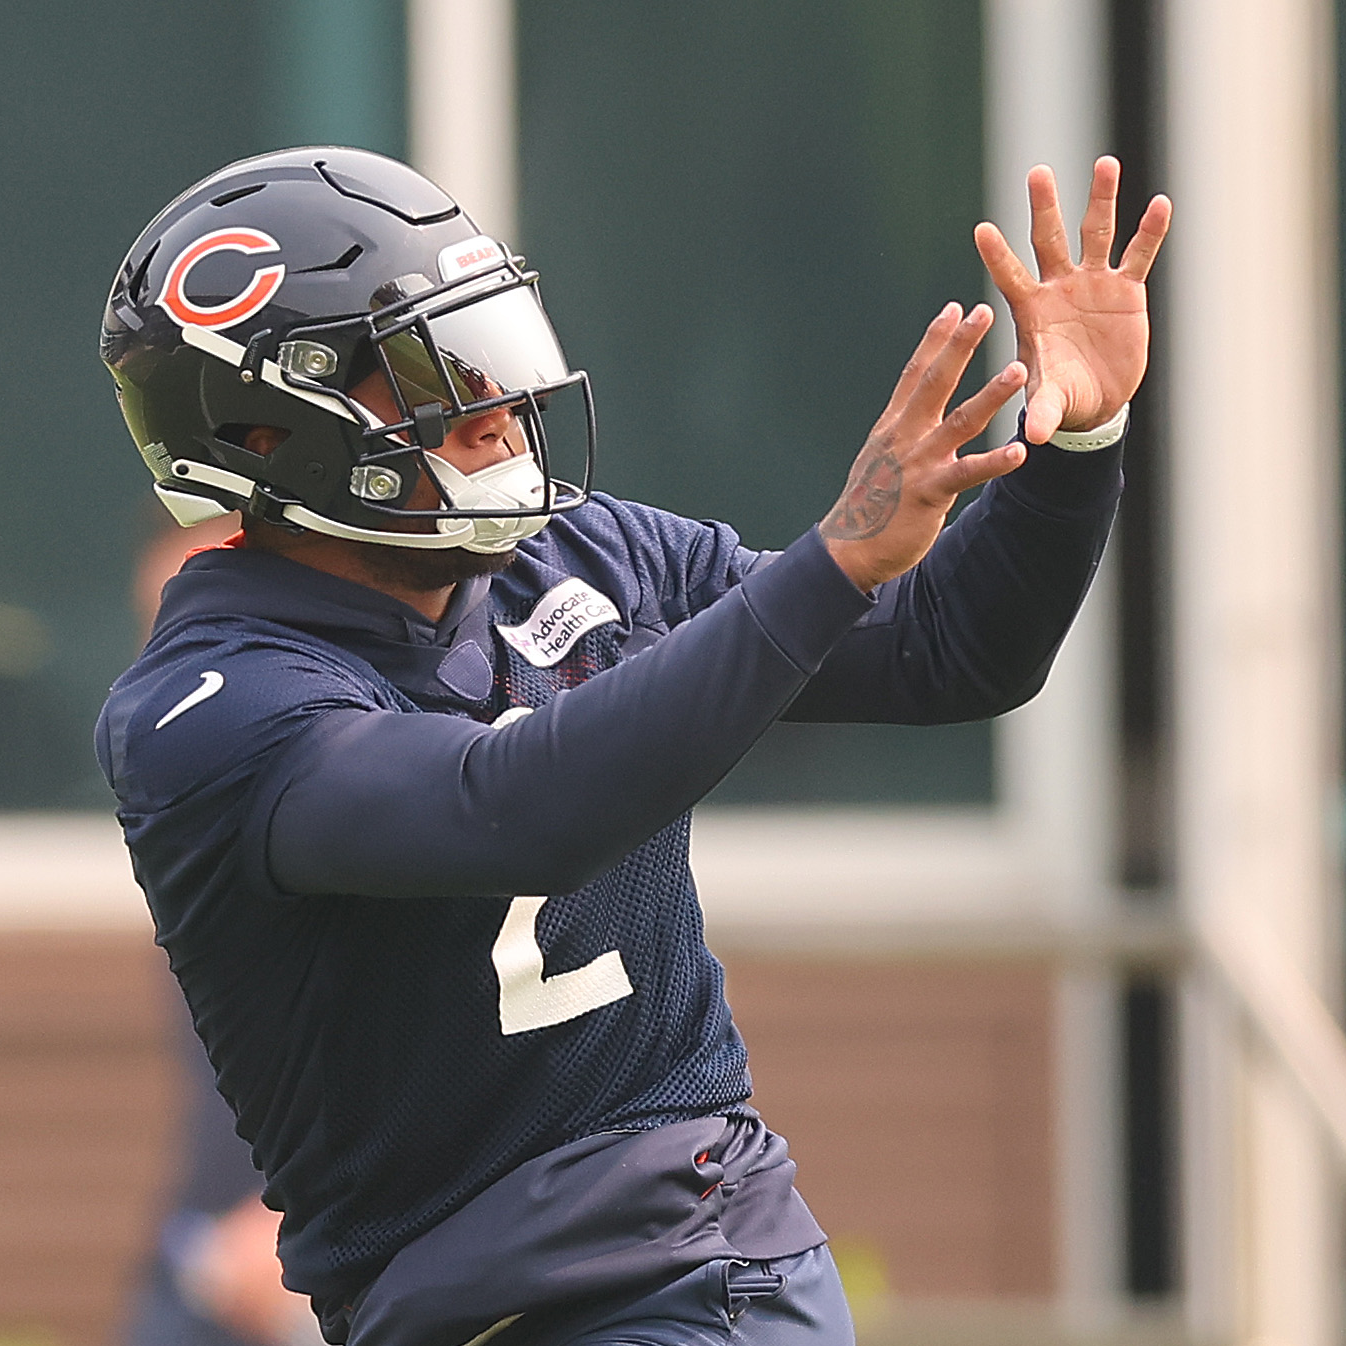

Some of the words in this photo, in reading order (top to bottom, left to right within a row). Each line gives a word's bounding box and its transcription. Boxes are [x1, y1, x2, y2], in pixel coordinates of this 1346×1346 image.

[155, 227, 285, 331] C
[531, 591, 591, 645] Advocate
[540, 614, 588, 658] Health
